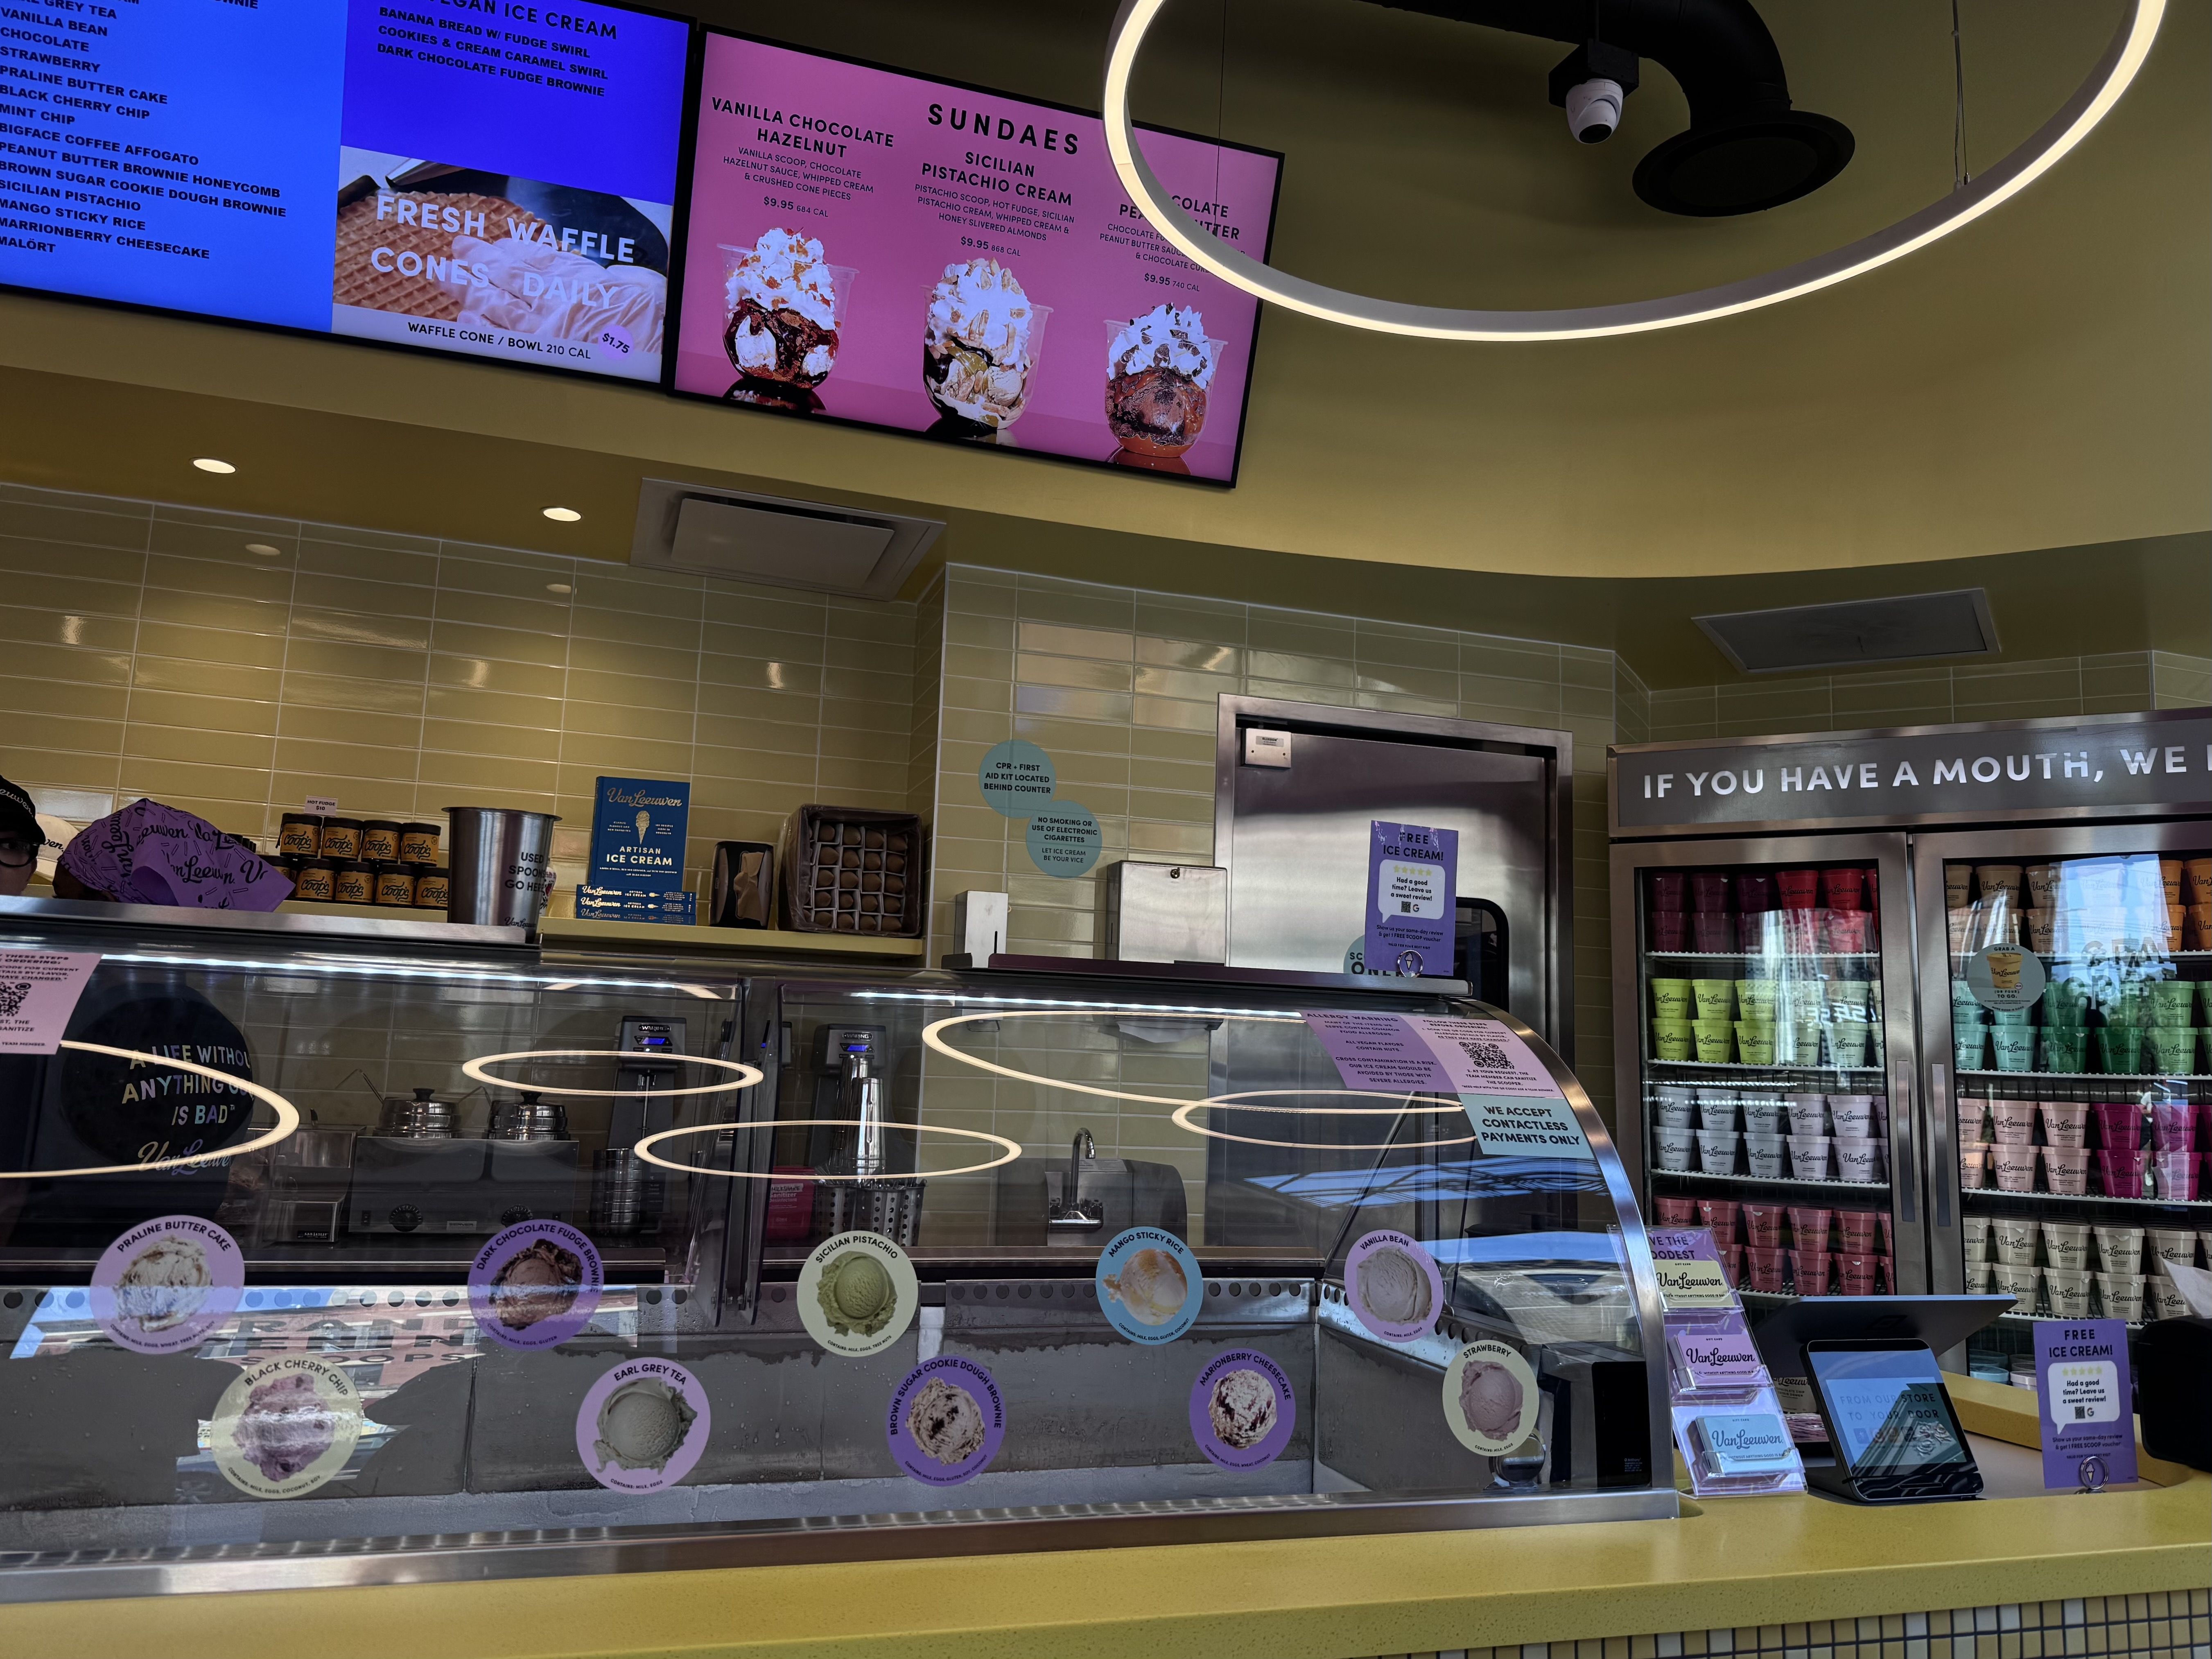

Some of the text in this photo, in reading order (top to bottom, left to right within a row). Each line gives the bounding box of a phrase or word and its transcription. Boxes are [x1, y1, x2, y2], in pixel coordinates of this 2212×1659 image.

[1, 7, 107, 36] VANILLA BEAN
[379, 7, 590, 58] BANANA BREAD W/ FUDGE SWIRL
[504, 1, 617, 39] ICE CREAM
[0, 27, 89, 52] CHOCOLATE
[0, 46, 101, 72] STRAWBERRY
[0, 66, 167, 104] PRALINE BUTTER CAKE
[0, 85, 150, 119] BLACK CHERRY CHIP
[712, 97, 894, 147] VANILLA CHOCOLATE
[928, 104, 1078, 154] SUNDAES
[757, 128, 847, 158] HAZELNUT
[0, 142, 280, 198] PEANUT BUTTER BROWNIE HONEYCOMB
[723, 156, 874, 193] HAZELNUT SAUCE, WHIPPED CREAM
[965, 151, 1034, 177] SICILIAN
[0, 180, 141, 211] SICILIAN PISTACHIO
[922, 163, 1071, 206] PISTACHIO CREAM
[764, 197, 829, 217] $9.95 684 CAL
[377, 195, 635, 263] FRESH WAFFLE
[939, 212, 1046, 240] HONEY SLIVERED ALMONDS
[961, 236, 989, 249] $9.95
[1007, 248, 1020, 256] CAL
[371, 247, 618, 309] CONES DAILY
[1144, 273, 1170, 285] $9.95
[408, 322, 591, 359] WAFFLE CONE / BOWL 210 CAL
[602, 332, 630, 354] $1.75
[1015, 774, 1049, 782] LOCATED
[1644, 746, 2187, 798] IF YOU HAVE A MOUTH, WE
[1014, 785, 1051, 793] COUNTER
[619, 846, 660, 854] ARTISAN
[1044, 834, 1085, 843] CIGARETTES
[1399, 832, 1428, 844] FREE
[521, 852, 544, 863] USED
[606, 854, 672, 866] ICE CREAM
[1383, 845, 1443, 861] ICE CREAM!
[508, 865, 546, 878] SPOONS
[505, 879, 544, 893] GO HERE
[122, 1074, 224, 1104] ANYTHING
[172, 1106, 188, 1126] IS
[1483, 1106, 1552, 1117] WE ACCEPT
[1482, 1119, 1568, 1131] CONTACTLESS
[1481, 1132, 1579, 1145] PAYMENTS ONLY
[117, 1221, 231, 1252] PRALINE BUTTER CAKE
[477, 1245, 497, 1270] DARK
[496, 1224, 556, 1246] CHOCOLATE
[558, 1227, 587, 1250] FUDGE
[1109, 1232, 1184, 1257] MANGO STICKY RICE
[1360, 1235, 1409, 1250] VANILLA BEAN
[816, 1236, 897, 1263] SICILIAN PISTACHIO
[2065, 1329, 2095, 1340] FREE
[1463, 1345, 1512, 1358] STRAWBERRY
[2049, 1345, 2113, 1358] ICE CREAM!
[245, 1360, 348, 1396] BLACK CHERRY CHIP
[614, 1364, 687, 1385] EARL GREY TEA
[1200, 1353, 1291, 1400] MARIONBERRY CHEESECAKE
[2085, 1379, 2099, 1387] good
[890, 1359, 1001, 1435] BROWN SUGAR COOKIE DOUGH BROWNIE
[1840, 1393, 1936, 1404] FROM OUR STORE
[1847, 1409, 1939, 1421] TO YOUR DOOR
